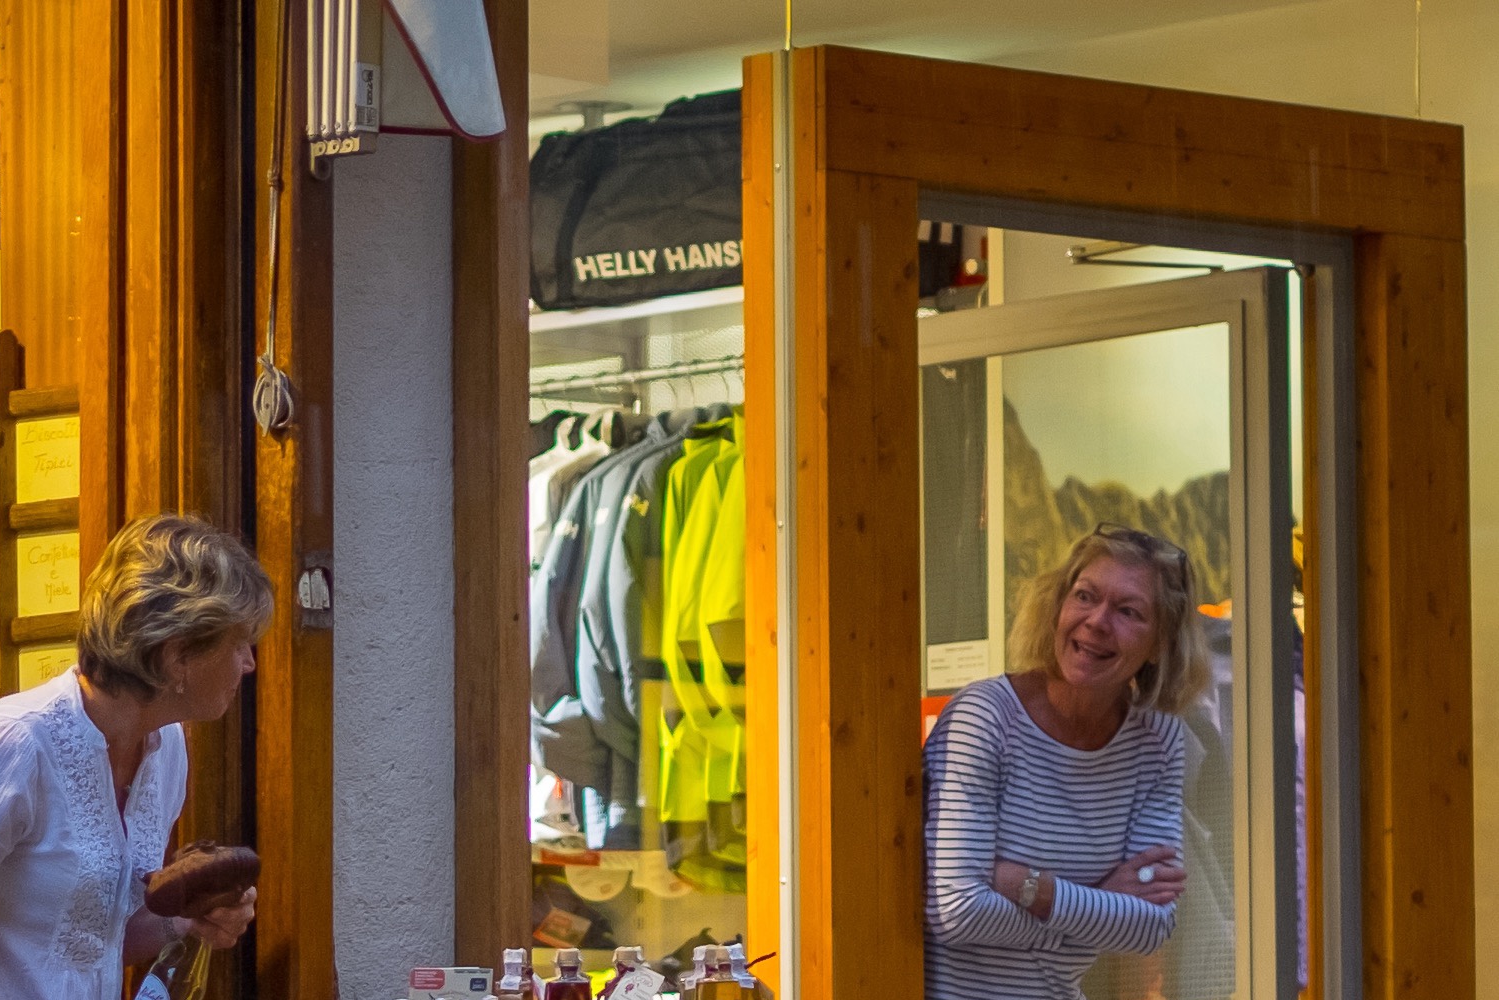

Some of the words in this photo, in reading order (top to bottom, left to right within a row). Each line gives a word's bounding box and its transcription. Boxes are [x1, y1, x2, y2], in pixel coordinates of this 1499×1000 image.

[574, 249, 657, 282] HELLY
[663, 239, 743, 273] HANS
[50, 568, 60, 580] e
[45, 583, 72, 603] Miele
